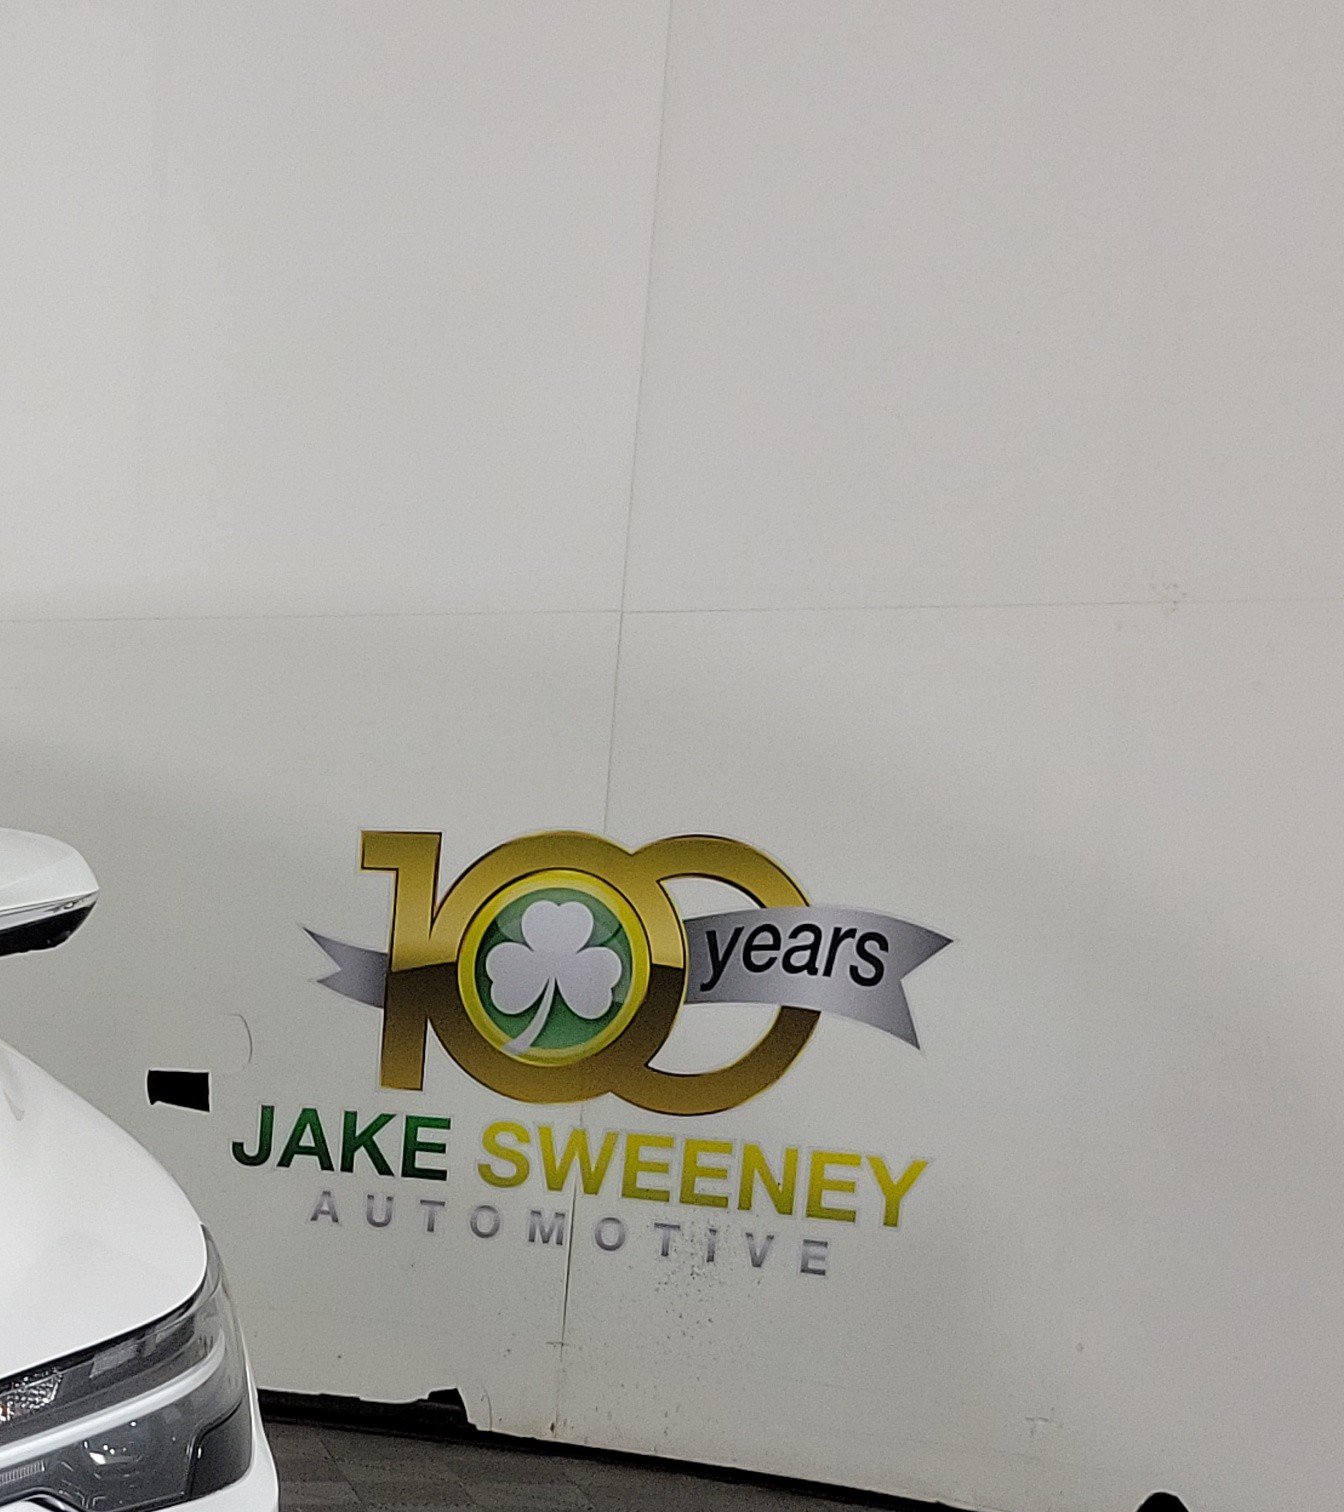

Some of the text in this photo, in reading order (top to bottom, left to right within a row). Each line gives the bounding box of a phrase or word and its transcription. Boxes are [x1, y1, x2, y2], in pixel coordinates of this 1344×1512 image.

[698, 922, 890, 992] years
[231, 1105, 928, 1228] JAKE SWEENEY
[310, 1190, 829, 1276] AUTOMOTIVE
